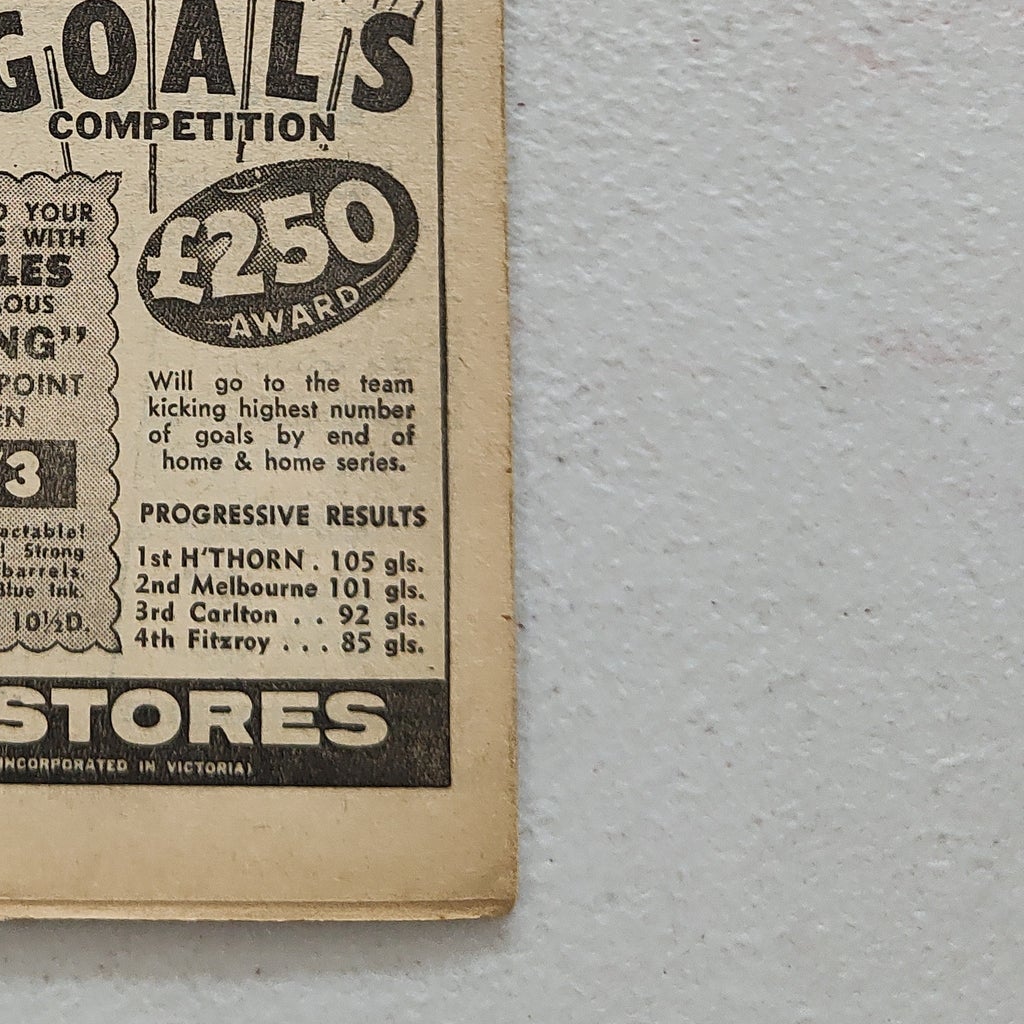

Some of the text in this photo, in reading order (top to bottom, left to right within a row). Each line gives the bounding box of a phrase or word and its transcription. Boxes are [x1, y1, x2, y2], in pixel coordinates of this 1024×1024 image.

[48, 110, 337, 142] COMPETITION
[25, 202, 94, 222] YOUR
[23, 228, 86, 248] WITH
[146, 179, 396, 305] £250
[229, 283, 361, 339] AWARD
[148, 369, 413, 395] Will go to the team
[148, 396, 415, 422] kicking highest number
[148, 423, 416, 449] of goals by end of
[162, 448, 406, 472] home & home series.
[140, 502, 427, 528] PROGRESSIVE RESULTS
[24, 543, 84, 562] Strong
[137, 545, 172, 568] 1st
[330, 550, 375, 572] 105
[384, 551, 424, 576] gls.
[134, 572, 425, 604] 2nd Melbourne 101 gls.
[135, 600, 425, 630] 3rd Carlton 92 gls.
[134, 626, 425, 658] 4th Fitzroy 85 gls.
[139, 759, 156, 773] IN
[166, 760, 252, 774] VICTORIA)
